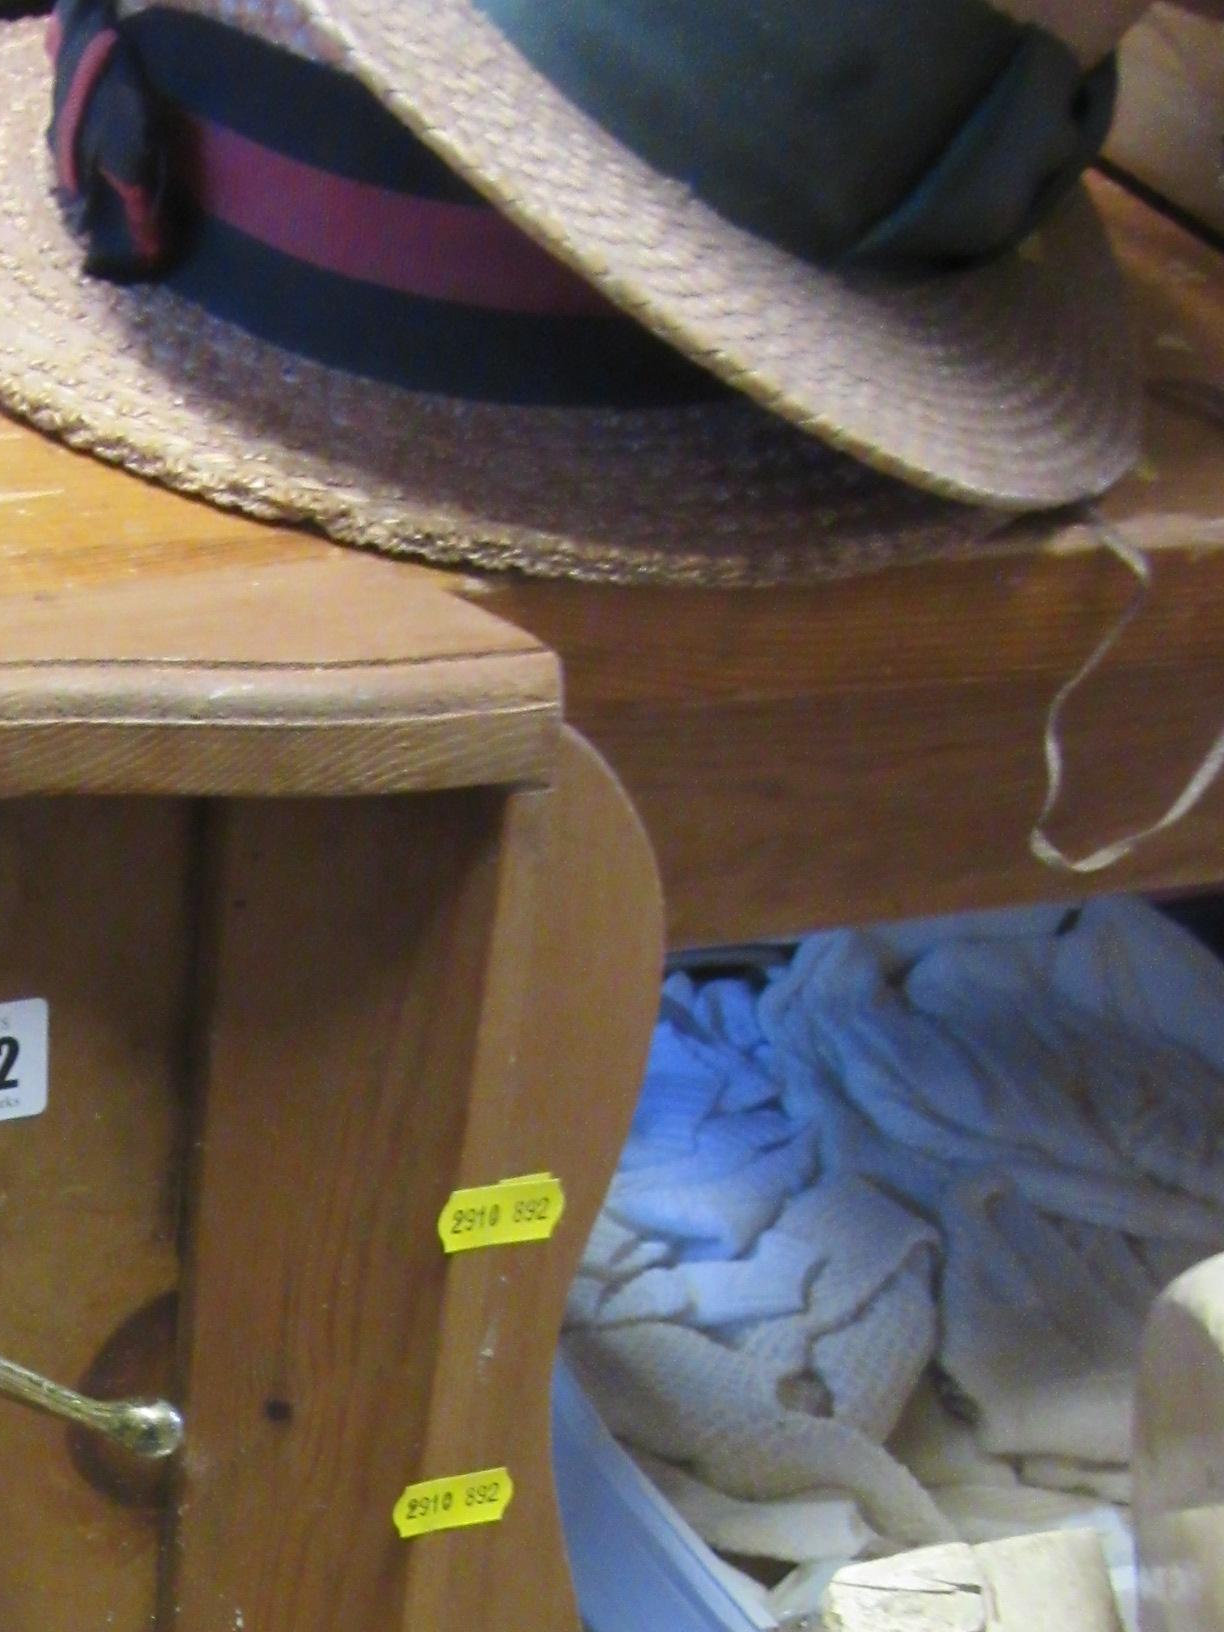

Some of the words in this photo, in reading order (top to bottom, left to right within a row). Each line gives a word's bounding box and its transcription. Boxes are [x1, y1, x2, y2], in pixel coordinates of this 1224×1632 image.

[450, 1203, 500, 1234] 2910
[513, 1197, 550, 1223] 892
[406, 1491, 453, 1519] 2910
[464, 1481, 499, 1506] 892
